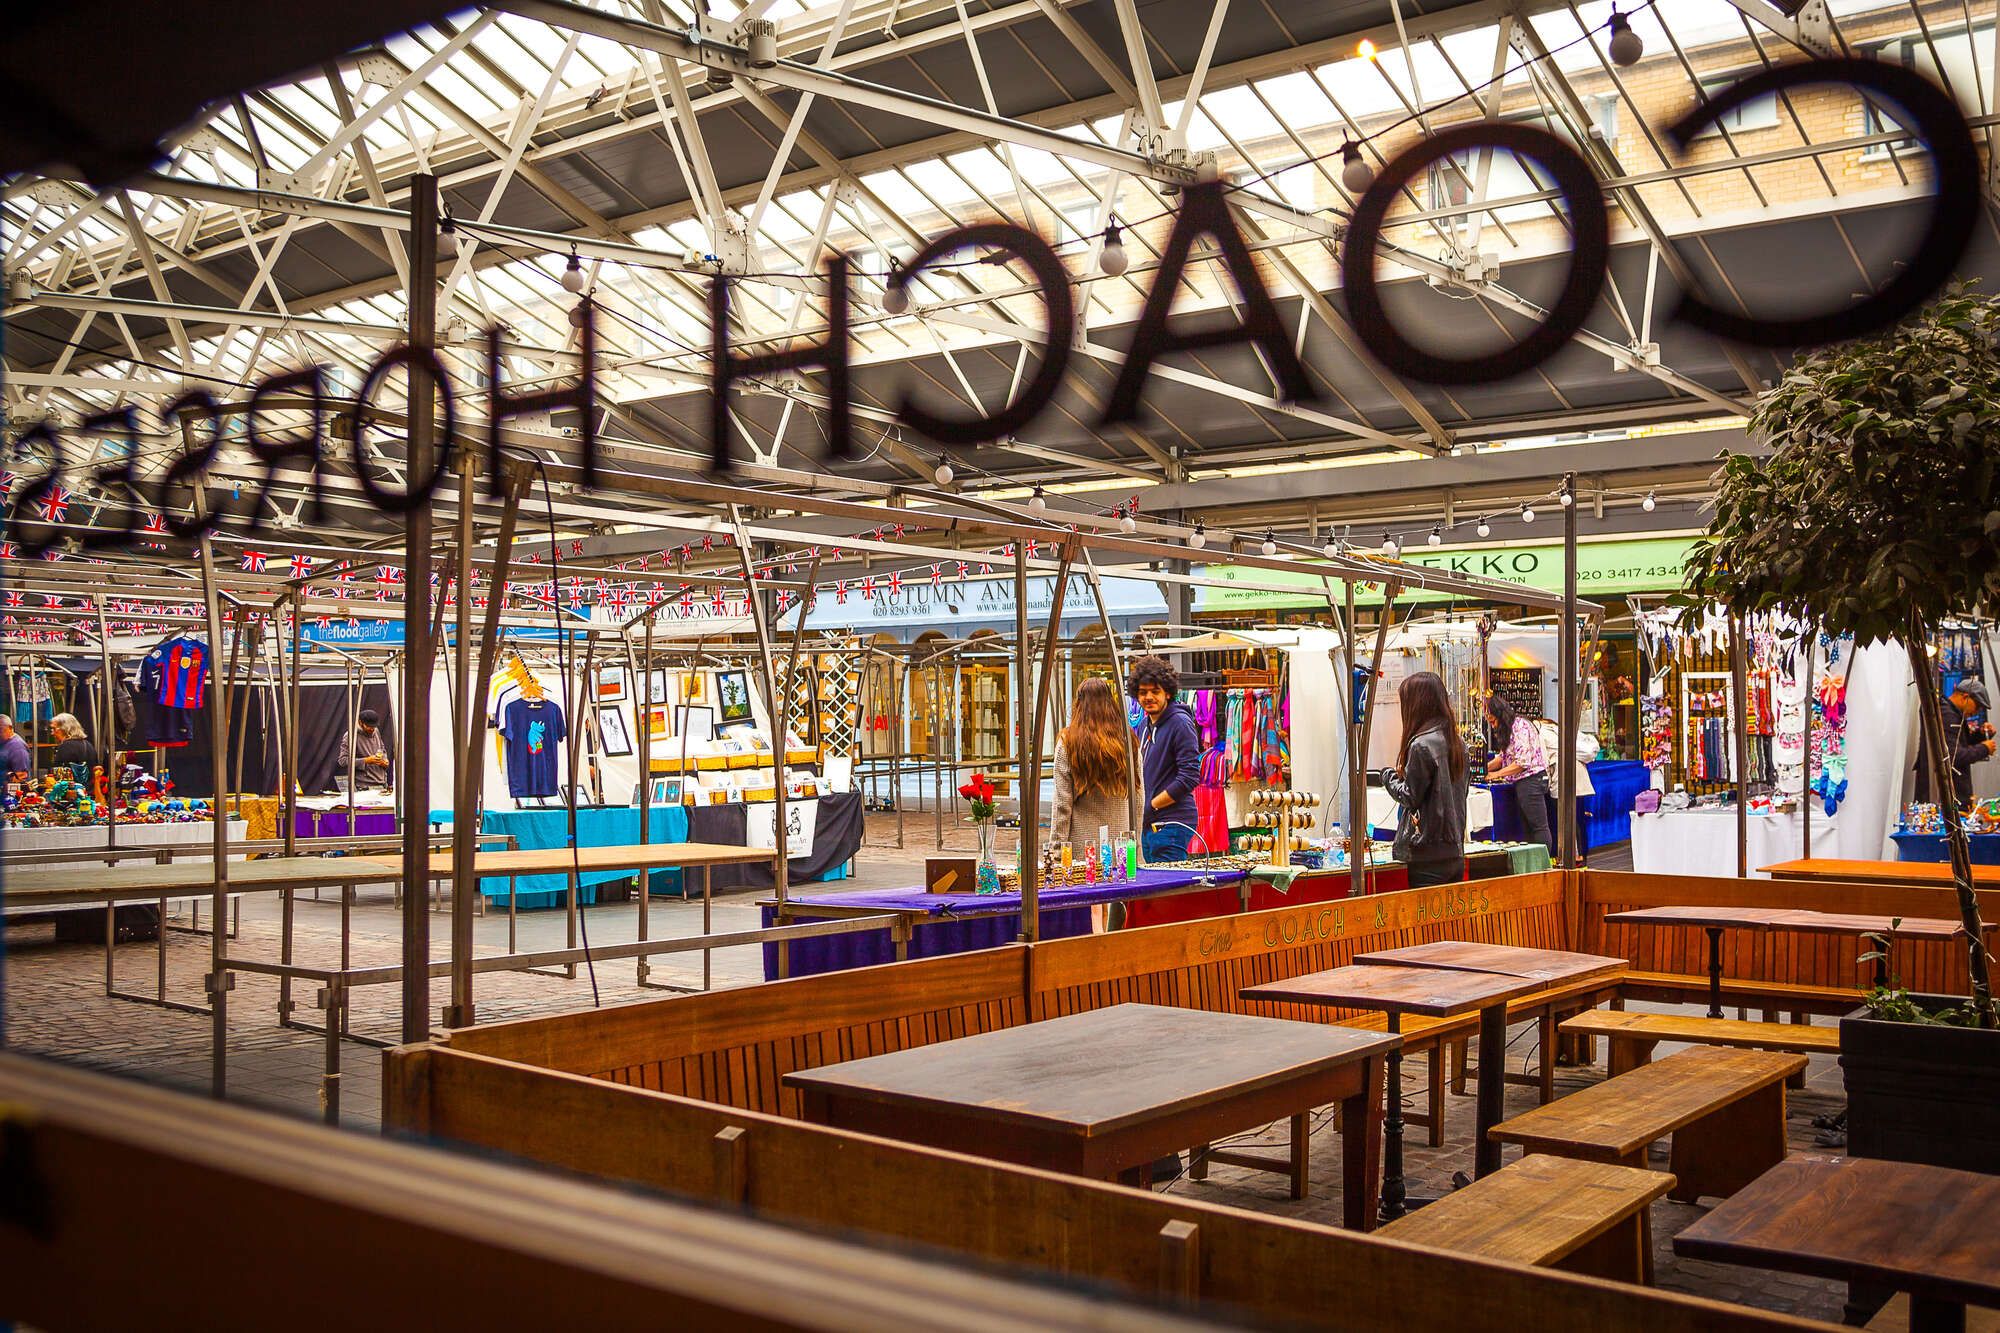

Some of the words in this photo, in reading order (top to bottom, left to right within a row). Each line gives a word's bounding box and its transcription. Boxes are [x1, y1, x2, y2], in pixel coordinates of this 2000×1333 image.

[1403, 553, 1539, 575] EKKO
[1607, 568, 1642, 579] 3417
[1646, 565, 1685, 577] 4341
[1226, 572, 1235, 580] 10
[873, 583, 966, 607] AUTUMN
[873, 607, 888, 617] 020
[890, 606, 909, 616] 8293
[912, 604, 931, 615] 9361
[152, 674, 161, 690] 7
[1199, 927, 1233, 956] The
[1264, 906, 1345, 947] COACH
[1375, 900, 1389, 929] &
[1416, 886, 1490, 921] HORSES
